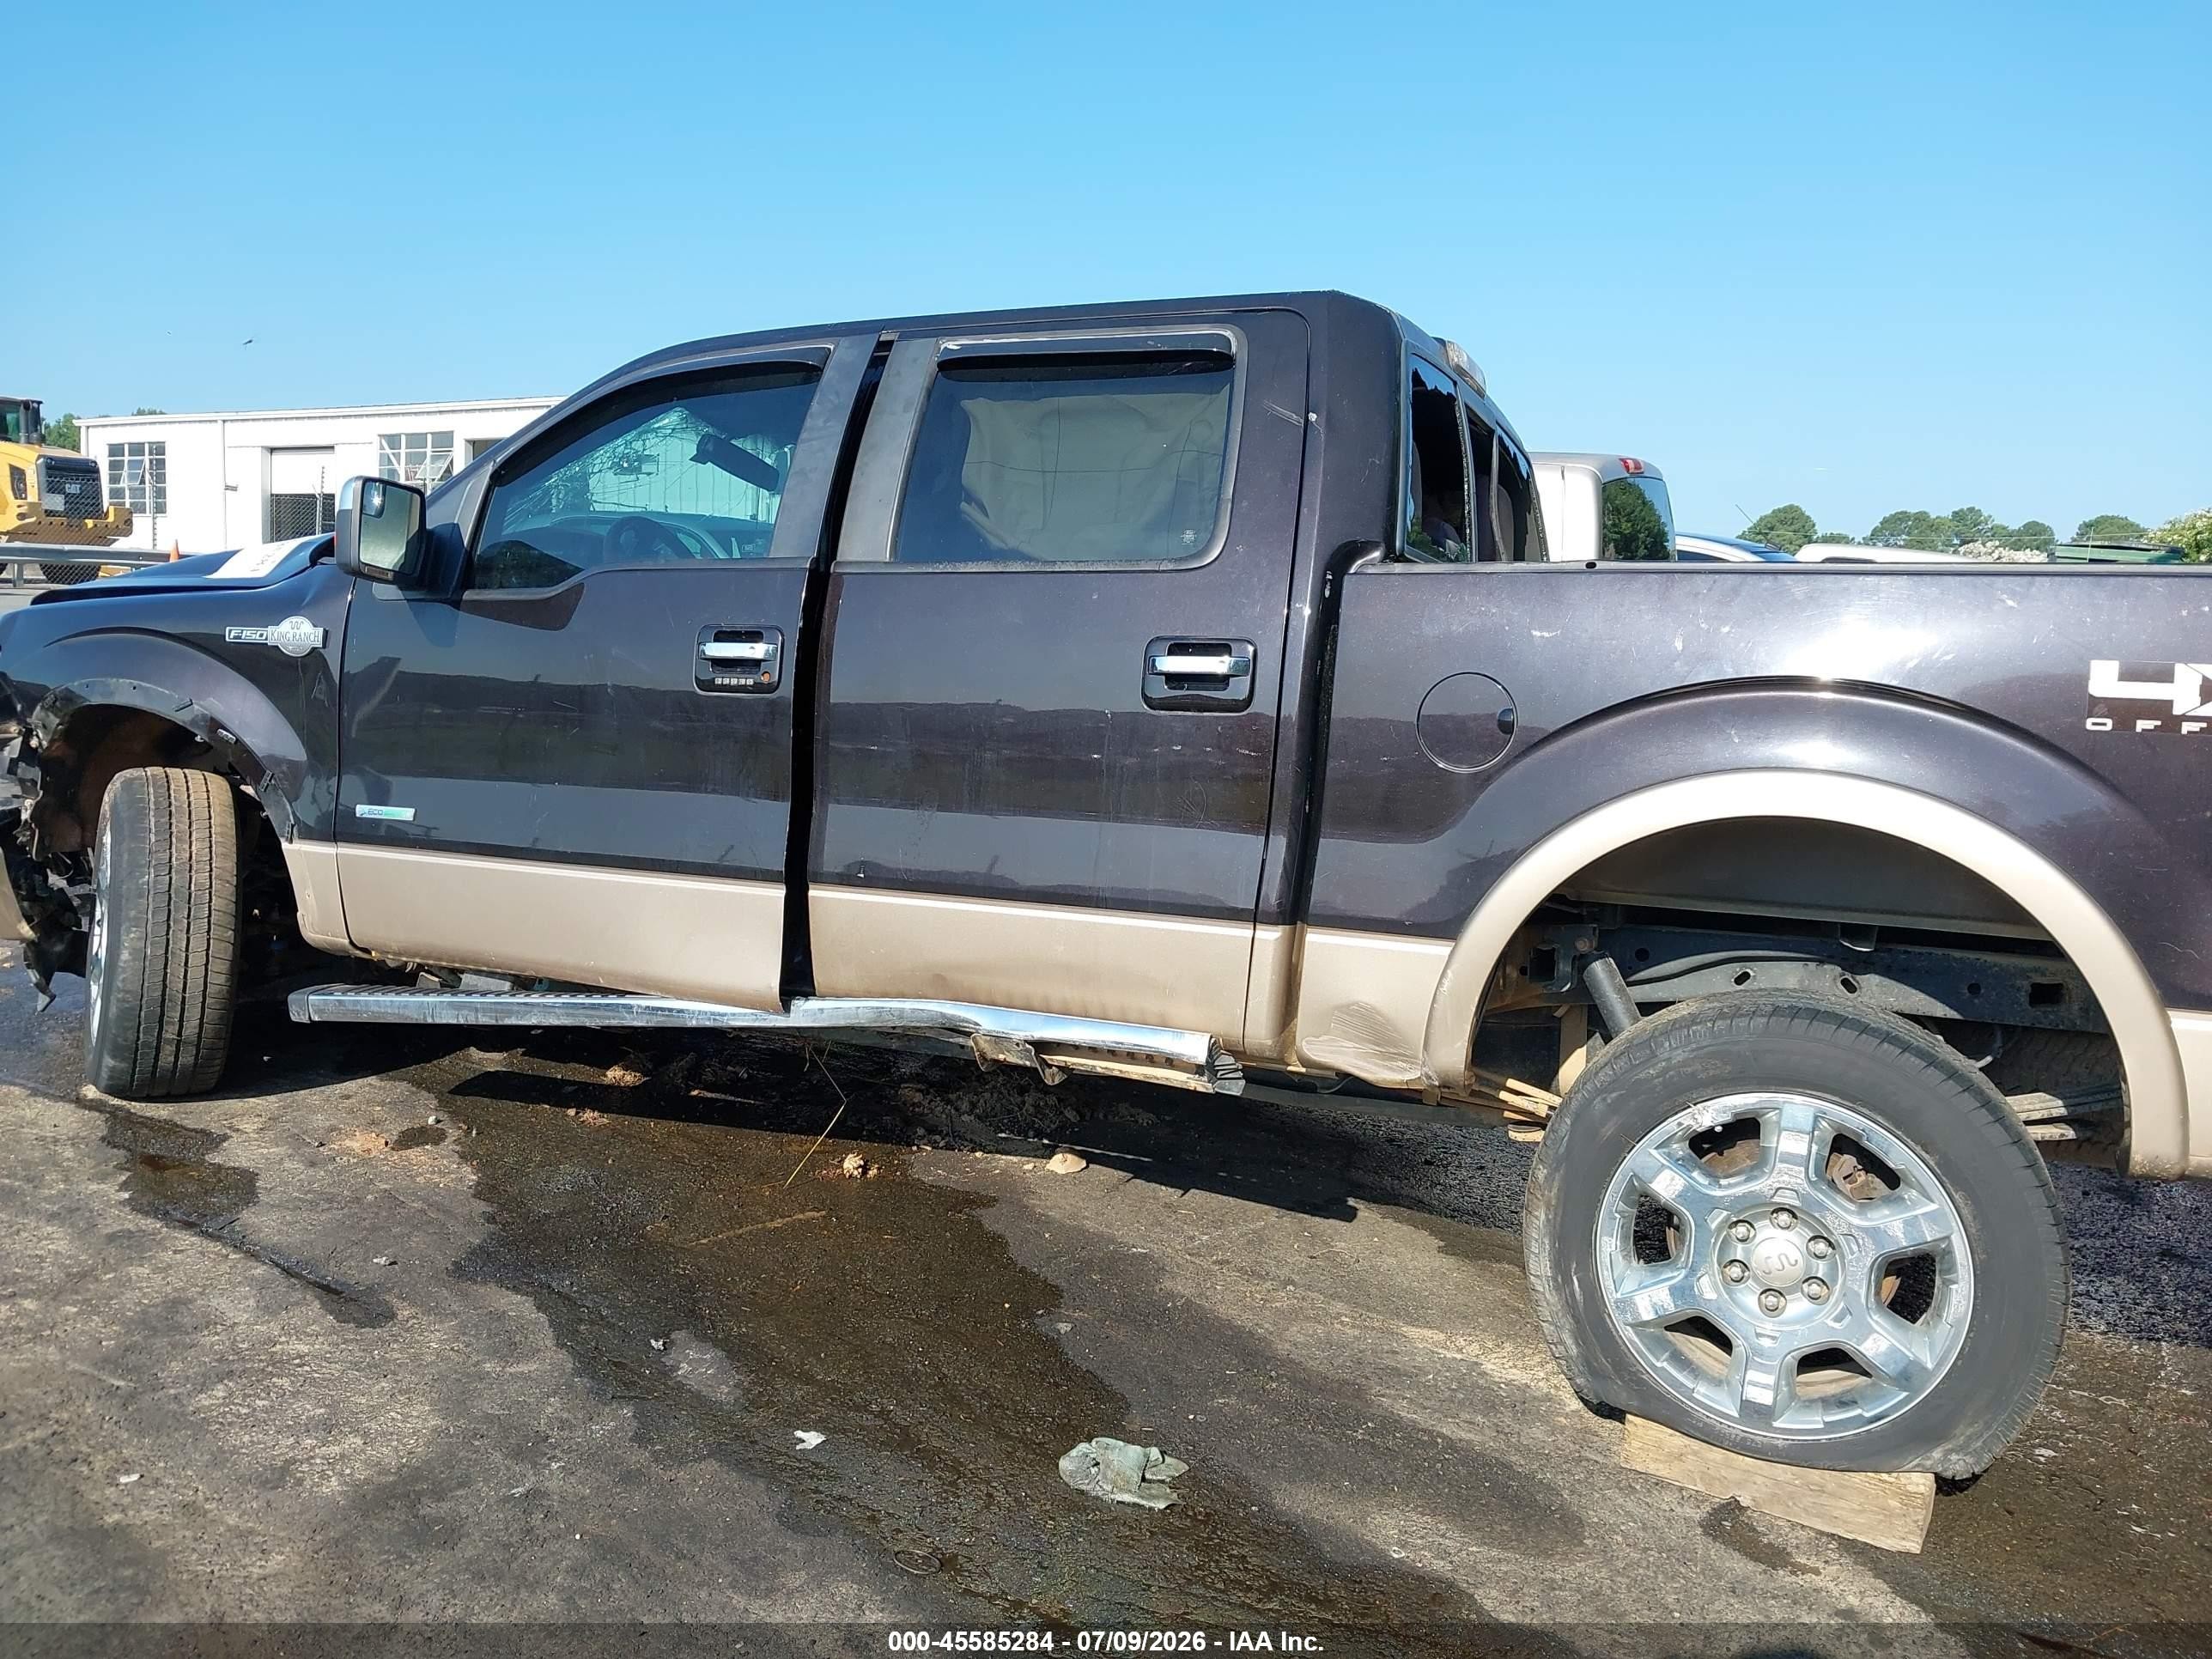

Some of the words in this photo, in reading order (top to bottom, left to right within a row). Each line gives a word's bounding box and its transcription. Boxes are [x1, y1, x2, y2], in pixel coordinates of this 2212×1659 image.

[229, 629, 268, 640] F-150
[270, 629, 290, 642] KING
[292, 630, 321, 643] RANCH
[2086, 718, 2208, 735] OFF
